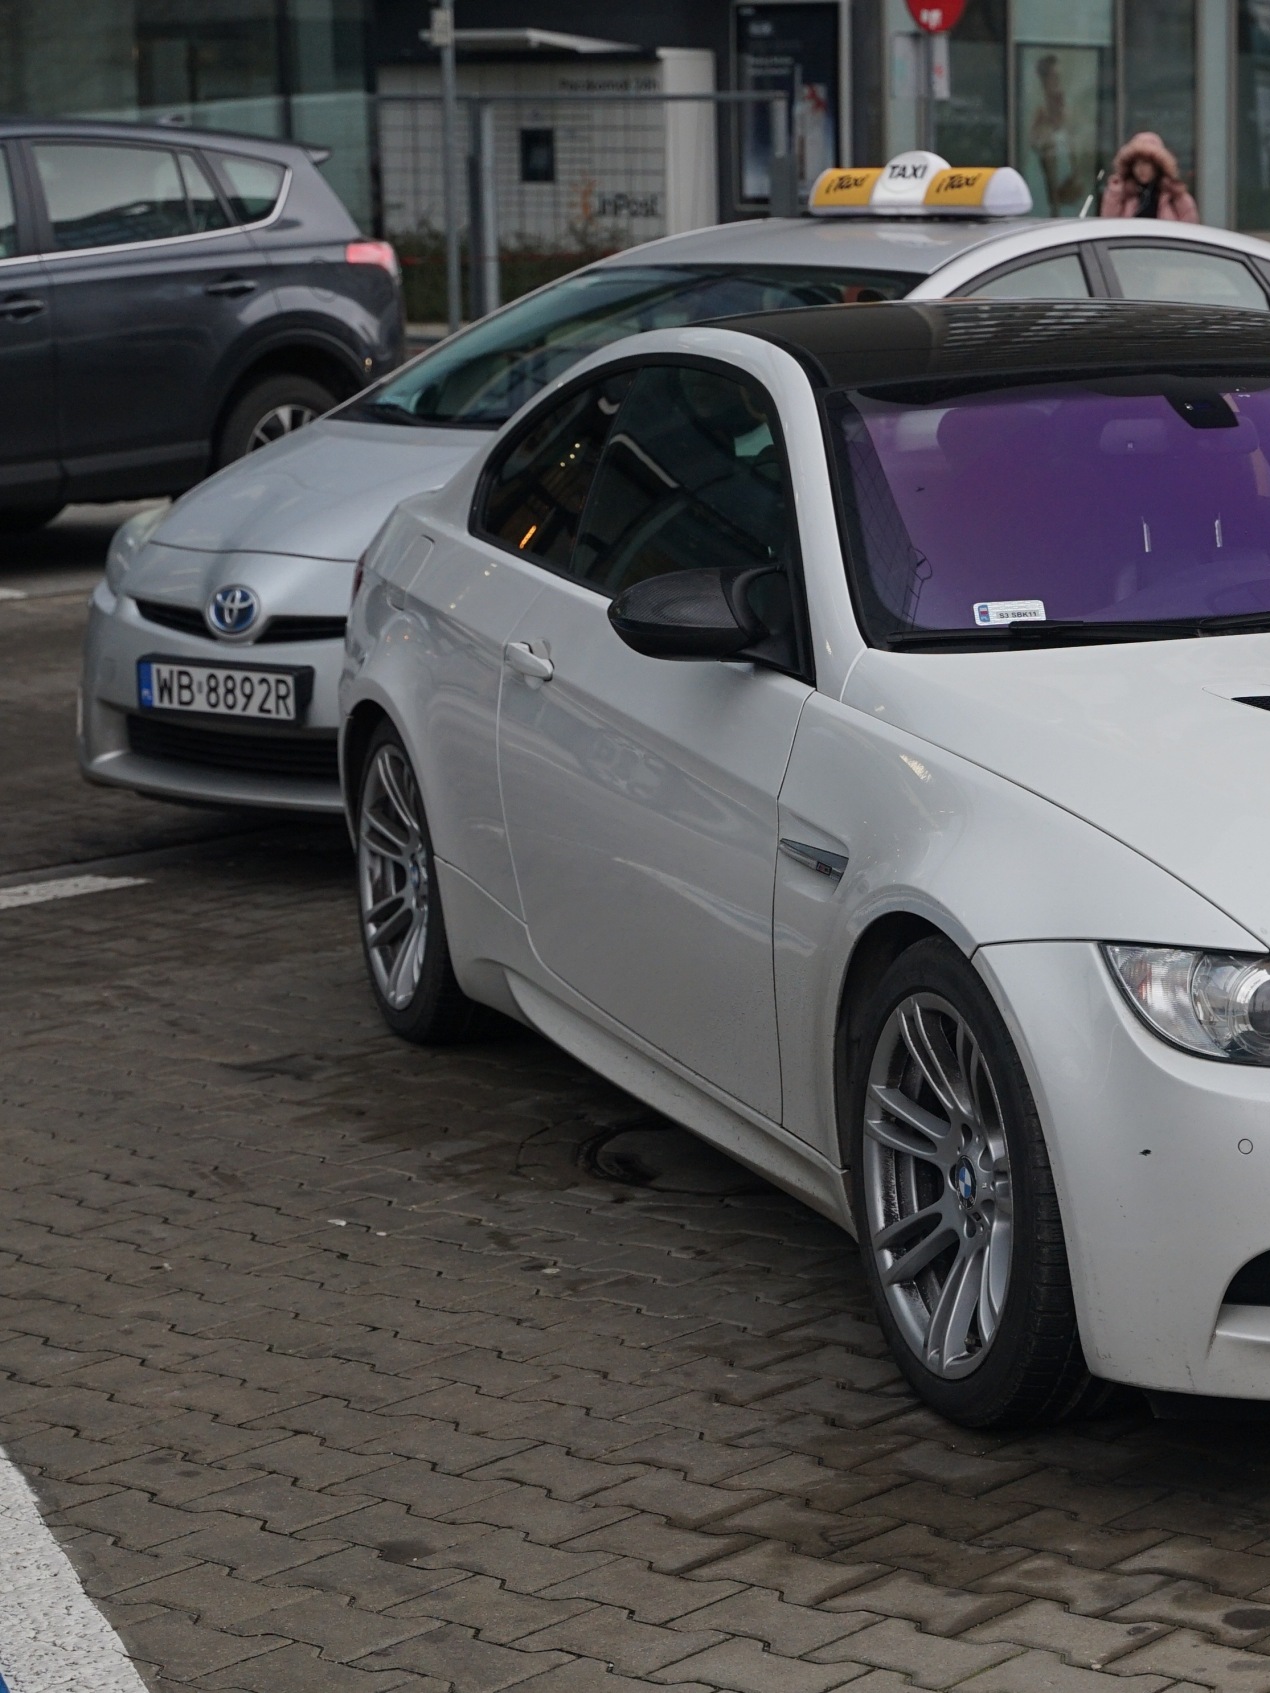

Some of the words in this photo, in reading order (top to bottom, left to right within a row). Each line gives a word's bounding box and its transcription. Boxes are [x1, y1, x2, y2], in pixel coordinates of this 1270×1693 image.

[888, 163, 928, 181] TAXI
[999, 611, 1010, 619] S3
[1012, 610, 1037, 618] SBK11
[155, 667, 195, 706] WB
[206, 672, 291, 717] 8892R
